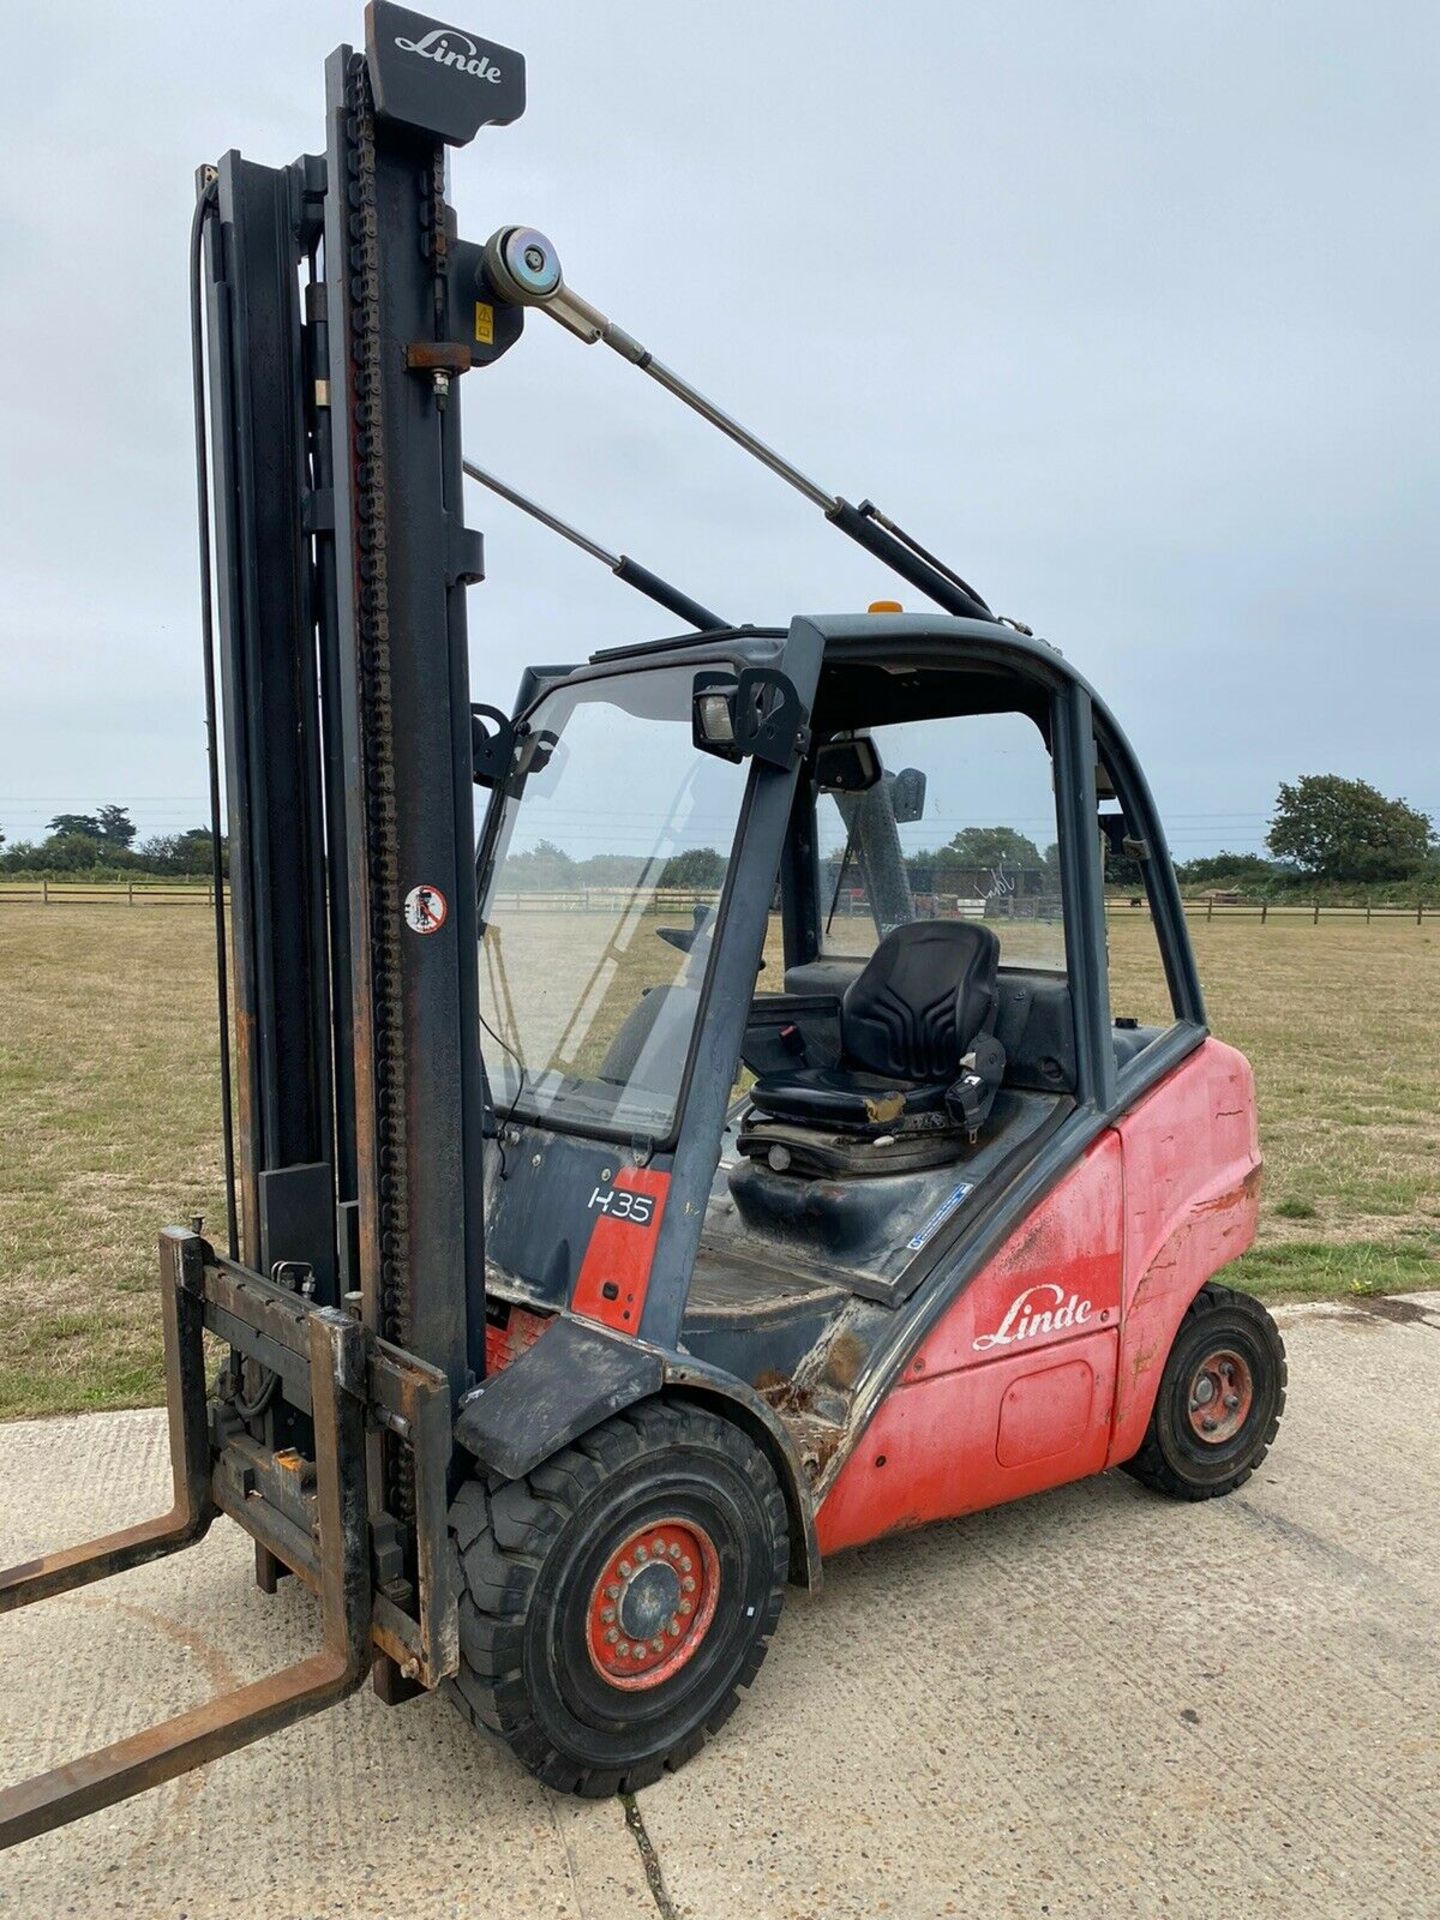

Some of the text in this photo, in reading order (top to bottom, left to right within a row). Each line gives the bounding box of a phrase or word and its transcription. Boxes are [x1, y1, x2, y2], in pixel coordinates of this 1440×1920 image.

[394, 29, 502, 84] Linde
[588, 1187, 652, 1223] H35
[972, 1283, 1092, 1351] Linde
